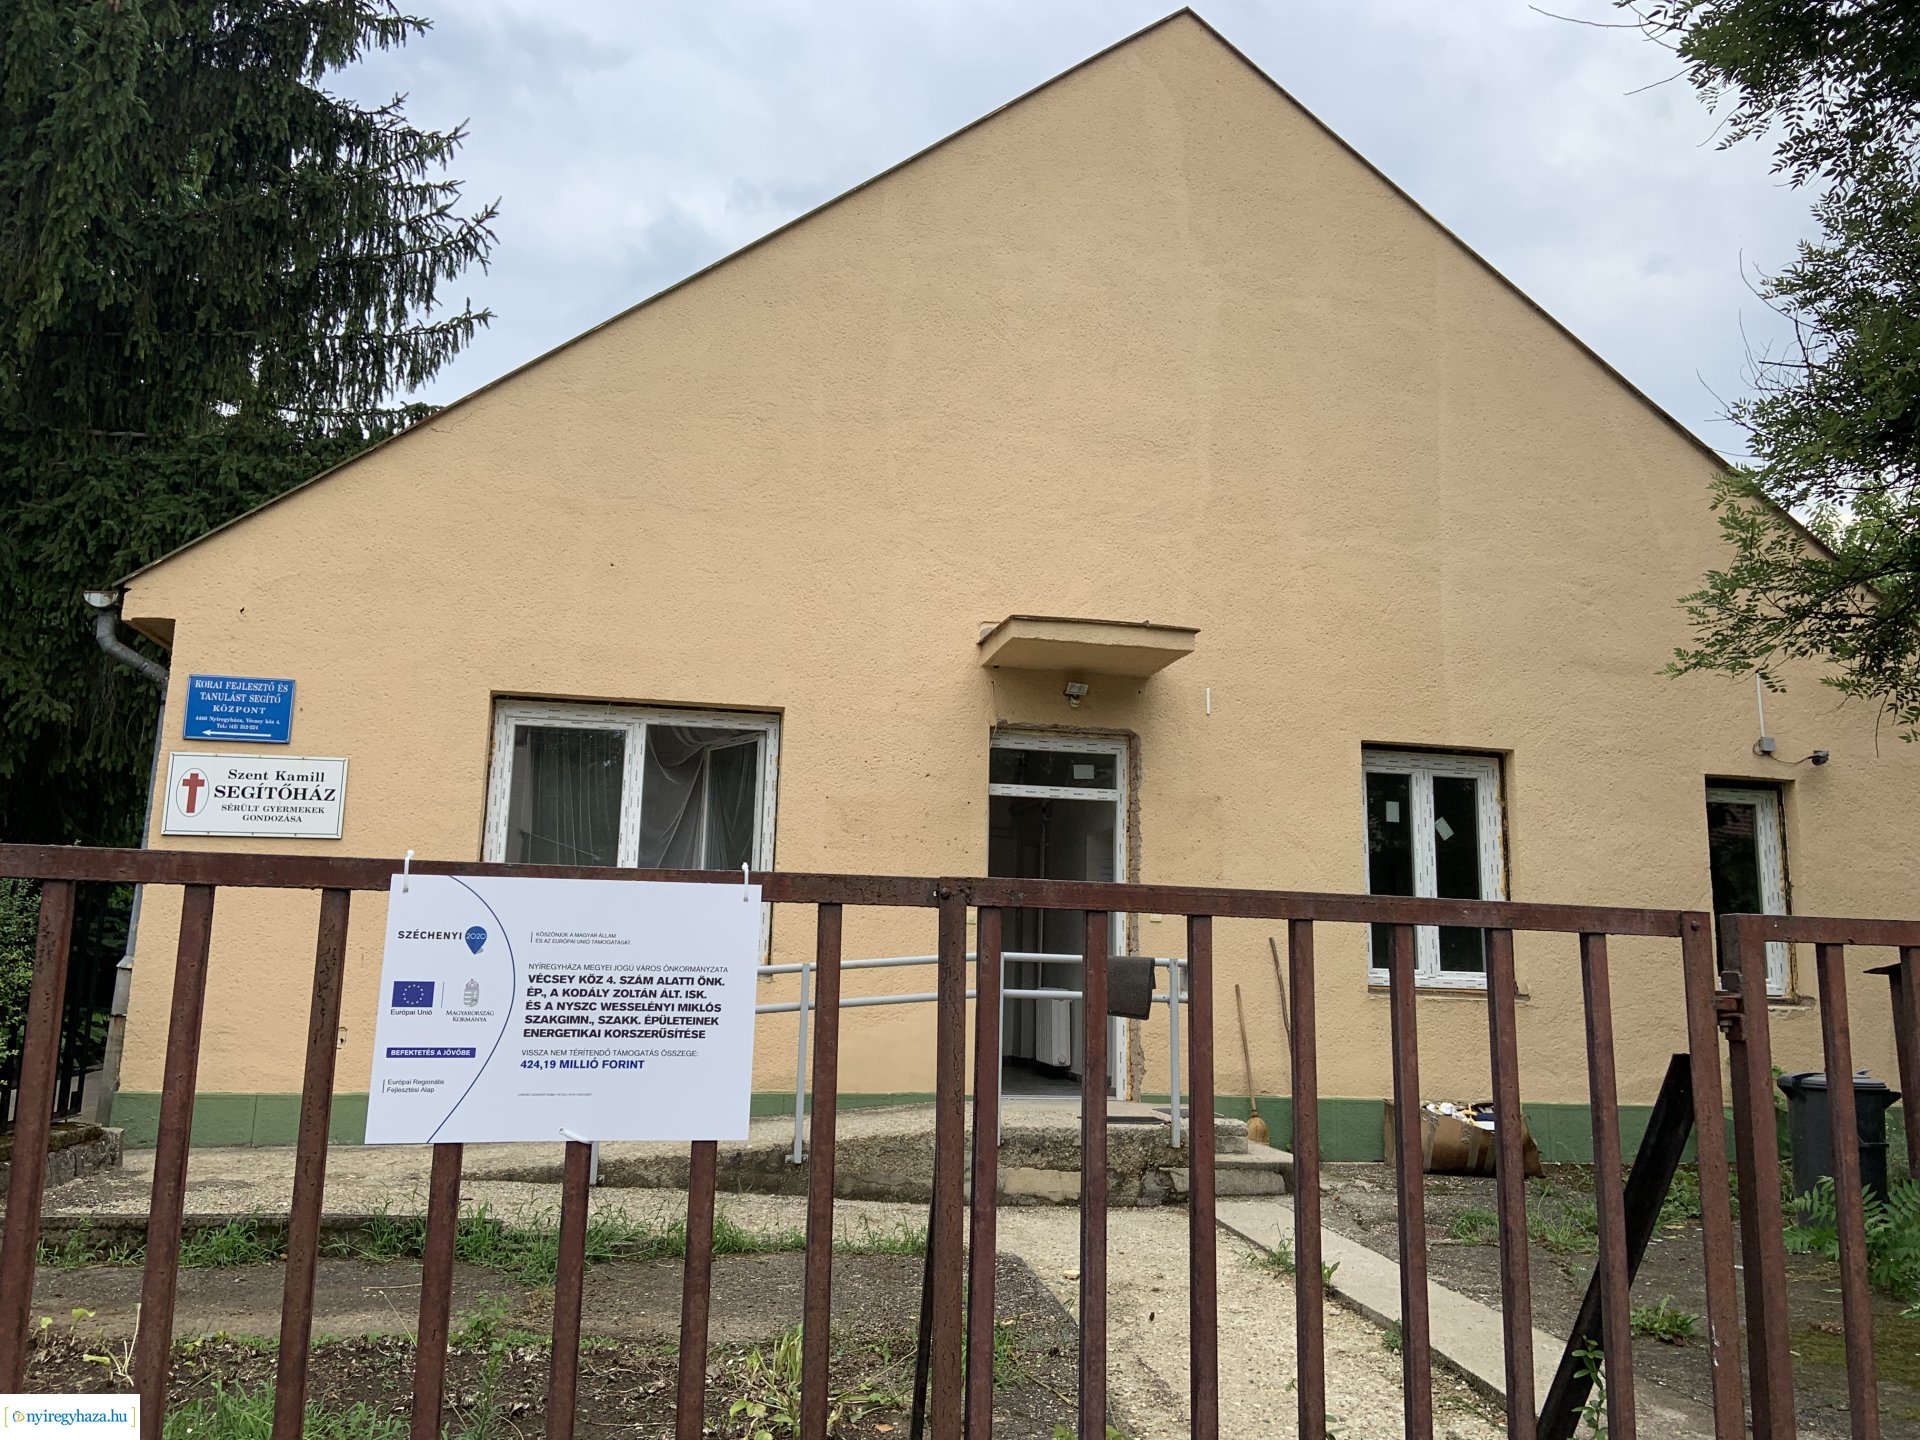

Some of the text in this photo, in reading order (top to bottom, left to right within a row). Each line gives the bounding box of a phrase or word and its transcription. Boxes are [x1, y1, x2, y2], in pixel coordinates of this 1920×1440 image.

[195, 680, 289, 693] KORAI FEJLESZTŐ ÉS
[200, 691, 281, 704] TANULÁST SEGÍTŐ
[213, 705, 266, 714] KÖZPONT
[227, 769, 325, 782] Szent Kamill
[214, 783, 336, 801] SEGÍTŐHÁZ
[221, 803, 325, 814] SÉRÜLT GYERMEKEK
[242, 814, 302, 823] GONDOZÁSA
[398, 929, 462, 940] SZÉCHENYI
[528, 963, 582, 971] NYÍREGYHÁZA
[614, 964, 635, 972] JOGÚ
[636, 964, 662, 972] VÁROS
[662, 965, 728, 973] ÖNKORMÁNYZATA
[528, 973, 725, 986] VÉCSEY KÖZ 4. SZÁM ALATTI ÖNK.
[526, 986, 707, 999] ÉP., A KODÁLY ZOLTÁN ÁLT. ISK.
[526, 1000, 721, 1012] ÉS A NYSZC WESSELÉNYI MIKLÓS
[390, 1009, 415, 1017] Európai
[524, 1014, 719, 1026] SZAKGIMN., SZAKK. ÉPÜLETEINEK
[523, 1028, 706, 1039] ENERGETIKAI KORSZERŰSÍTÉSE
[569, 1048, 611, 1056] TÉRÍTENDŐ
[612, 1048, 659, 1057] TÁMOGATÁS
[661, 1049, 698, 1057] ÖSSZEGE:
[520, 1057, 645, 1070] 424,19 MILLIÓ FORINT
[413, 1079, 445, 1087] Regionális
